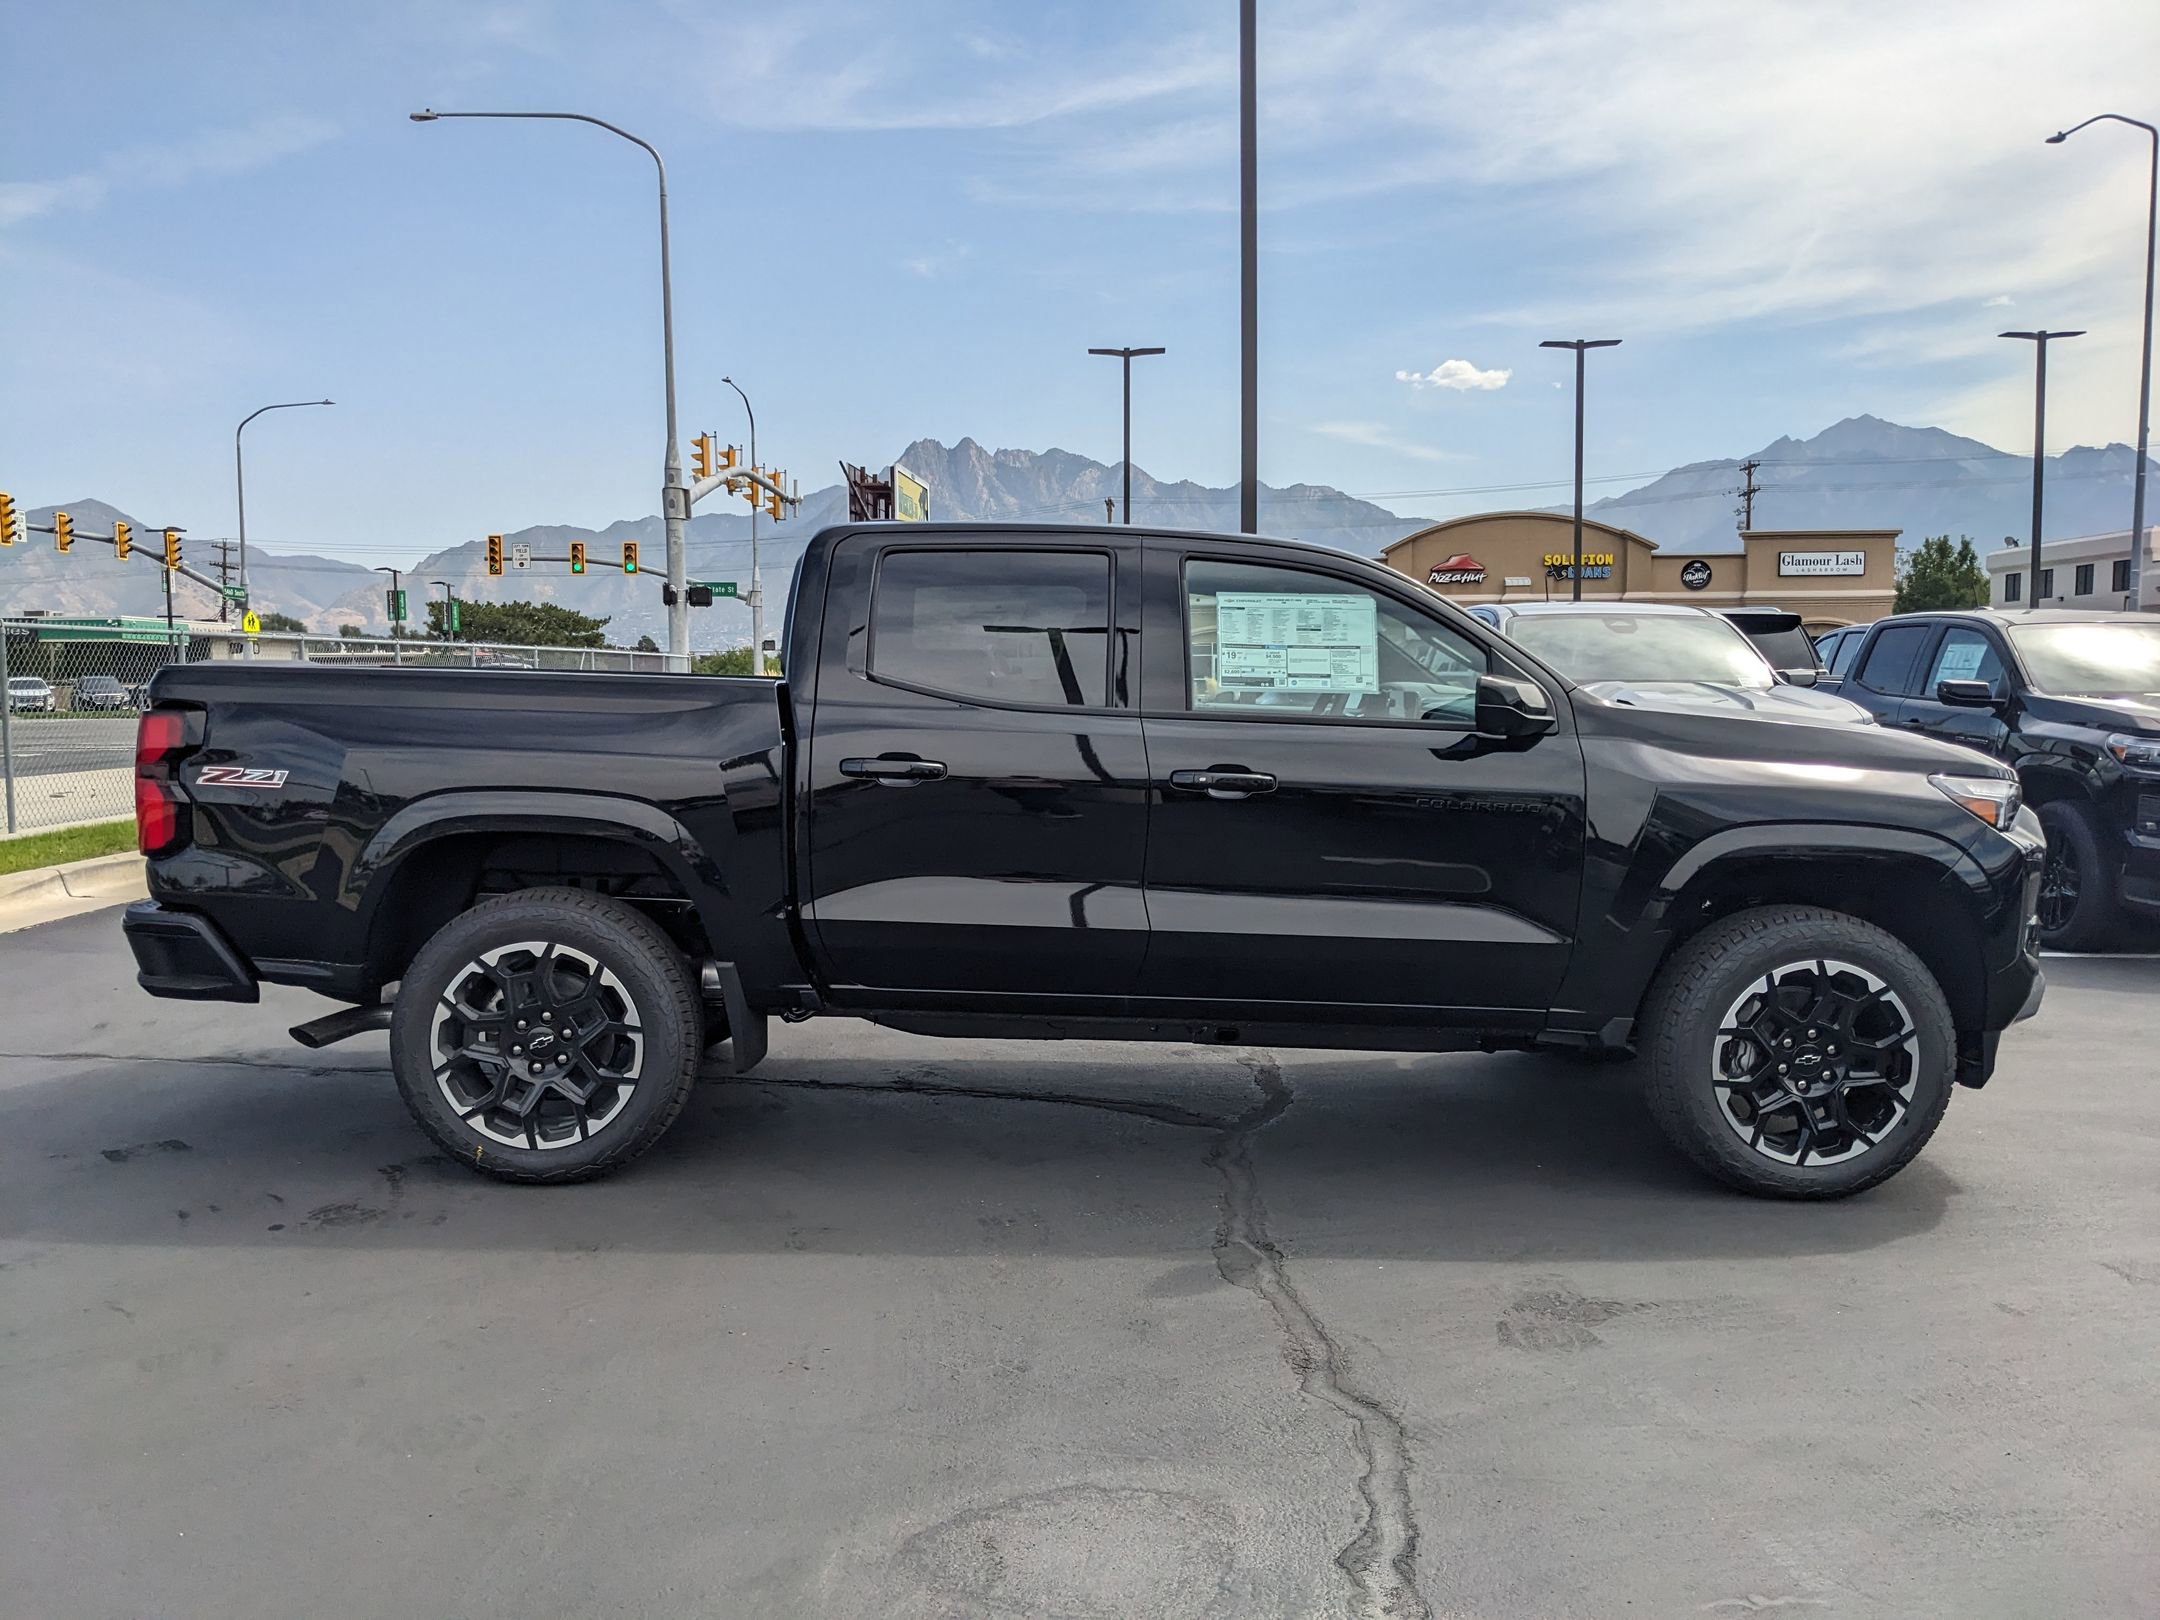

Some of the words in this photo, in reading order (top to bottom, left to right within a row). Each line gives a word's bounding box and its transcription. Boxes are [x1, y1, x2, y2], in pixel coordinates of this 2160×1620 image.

[1782, 554, 1832, 567] Glamour
[1834, 554, 1862, 566] Lash
[1428, 572, 1460, 584] Pizza
[1460, 571, 1488, 583] Hut
[196, 766, 289, 788] Z71
[1415, 798, 1543, 813] COLORADO
